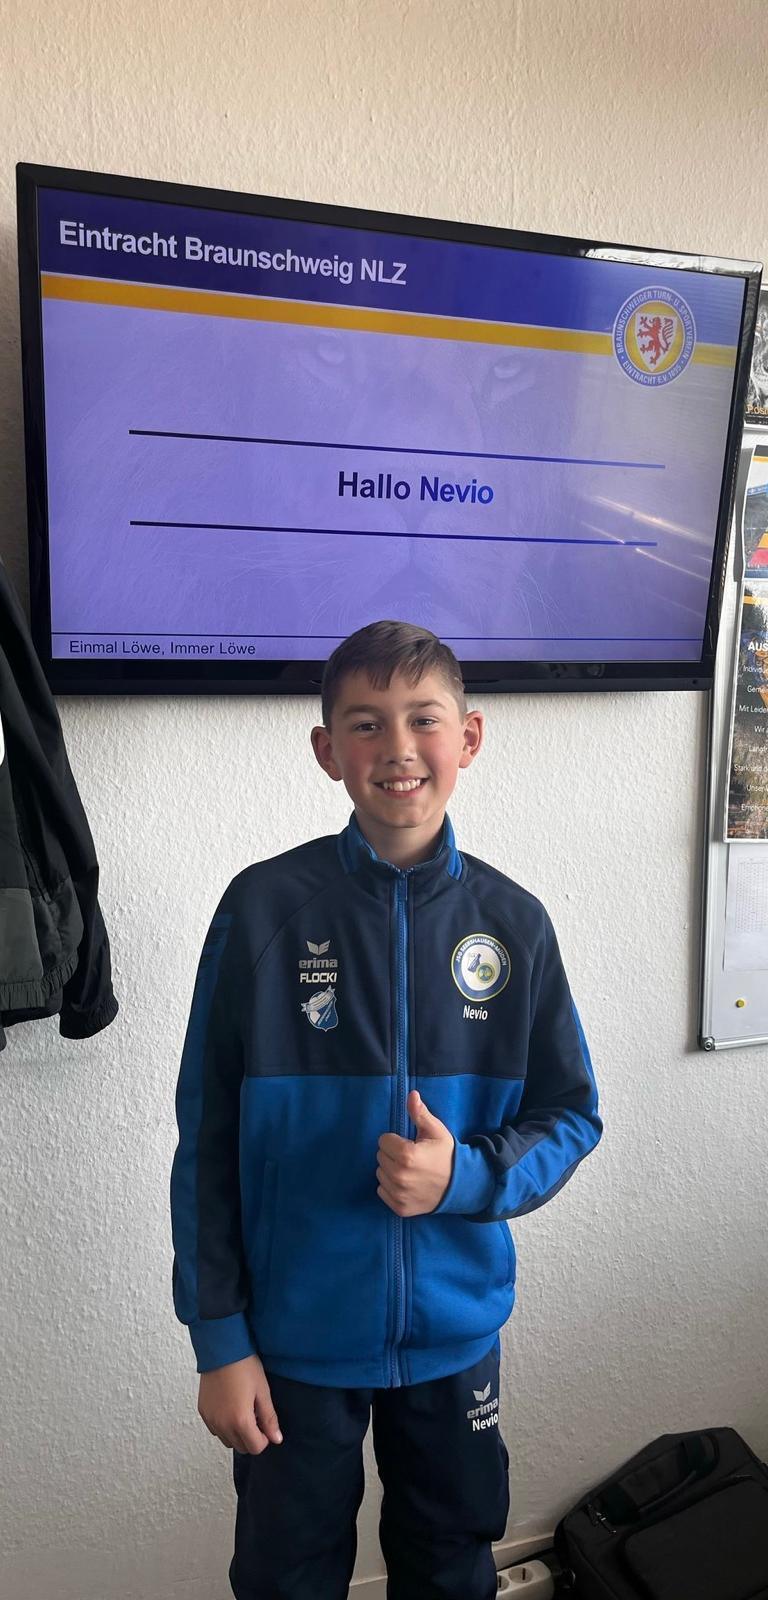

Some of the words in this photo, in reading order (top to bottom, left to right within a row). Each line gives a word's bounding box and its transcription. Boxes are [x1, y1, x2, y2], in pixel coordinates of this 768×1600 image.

[59, 220, 178, 259] Eintracht
[184, 235, 354, 284] Braunschweig
[360, 257, 407, 285] NLZ
[615, 290, 653, 354] BRAUNSCHWEIGER
[679, 304, 693, 361] SPORTVEREIN
[622, 360, 657, 385] EINTRACHT
[338, 471, 411, 500] Hallo
[420, 475, 494, 504] Nevio
[69, 640, 118, 654] Einmal
[122, 641, 165, 656] Löwe,
[170, 641, 215, 655] Immer
[219, 642, 256, 655] Löwe
[739, 704, 750, 712] Mit
[299, 957, 338, 969] erima
[300, 972, 337, 983] FLOCKI
[463, 1004, 488, 1021] Nevio
[466, 1397, 499, 1419] erima
[472, 1412, 499, 1432] Nevio
